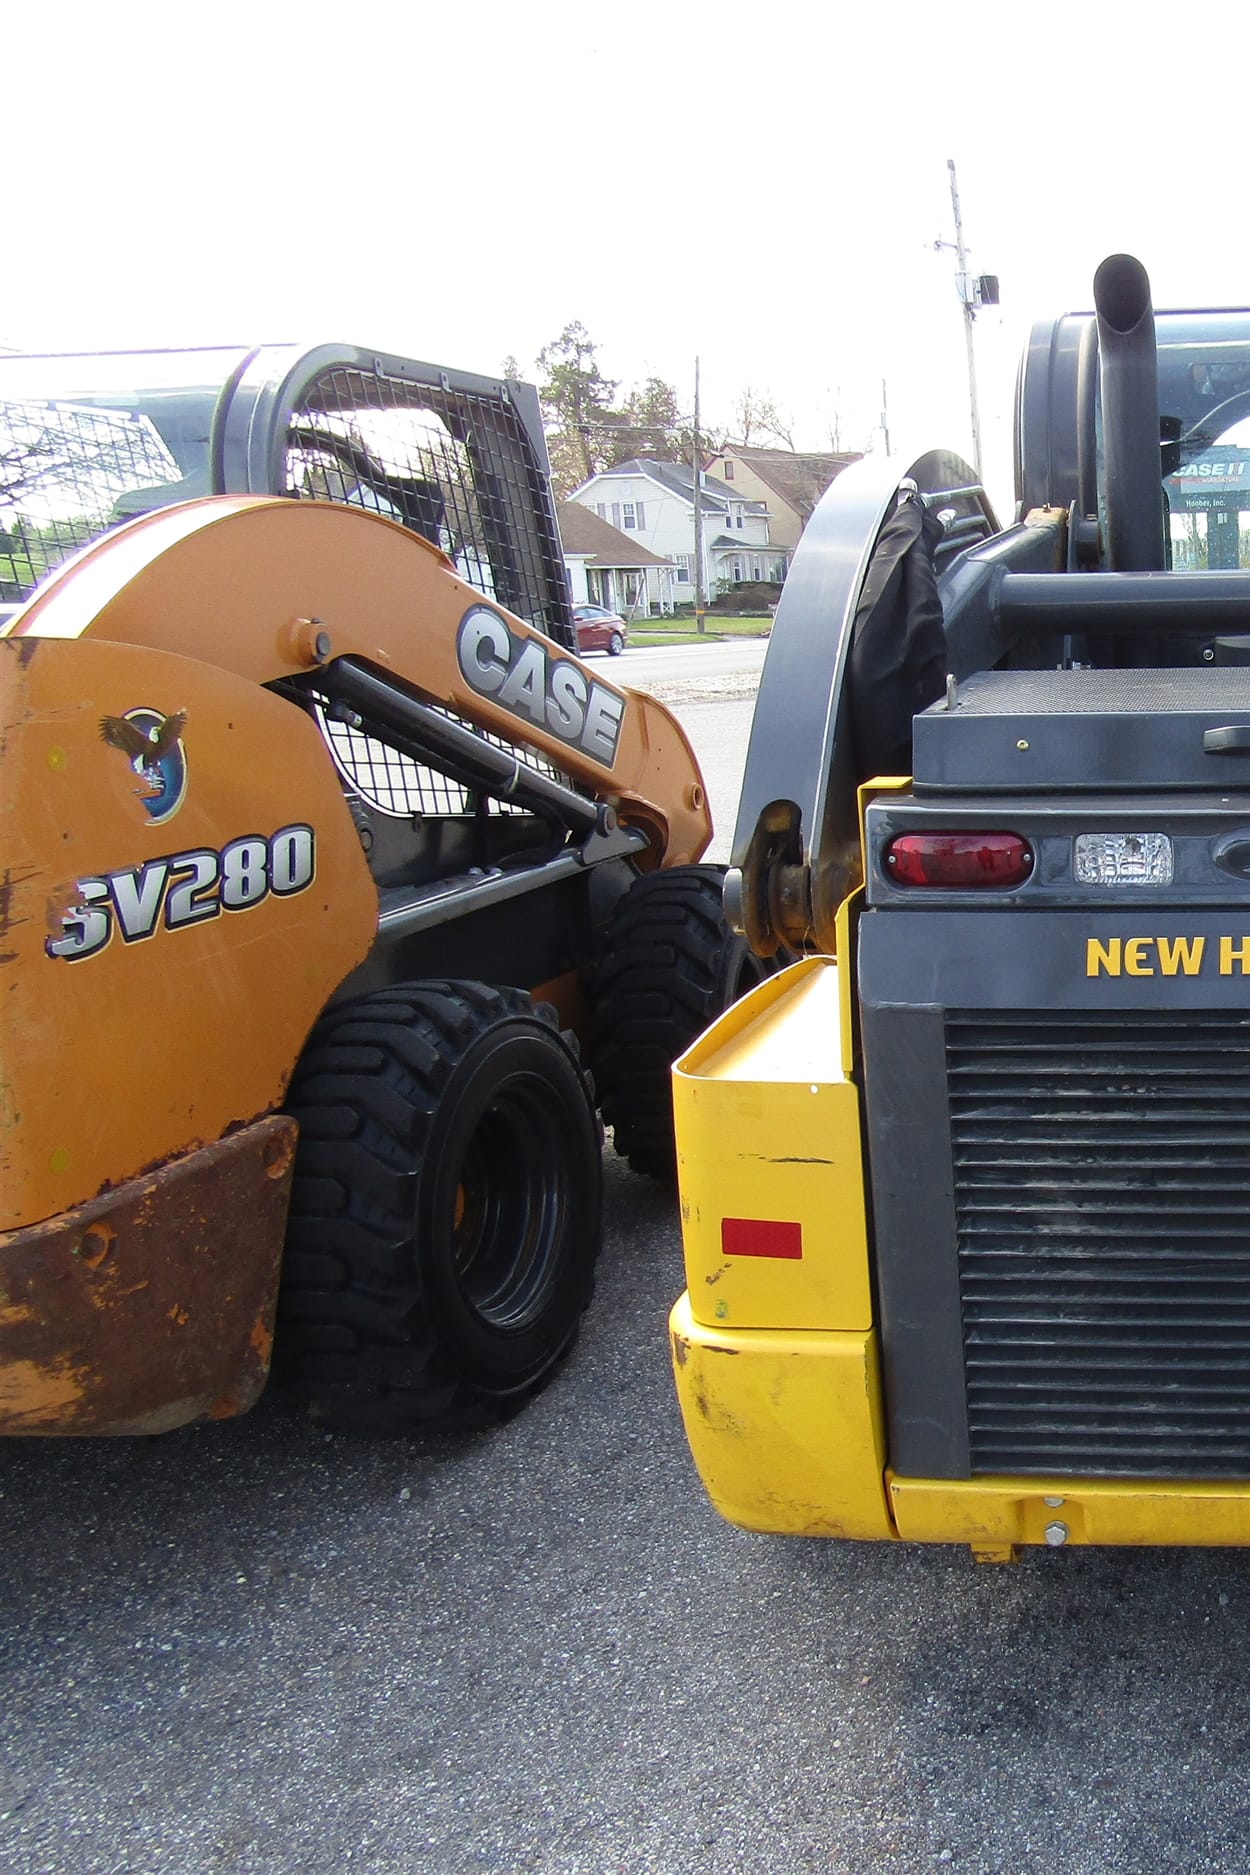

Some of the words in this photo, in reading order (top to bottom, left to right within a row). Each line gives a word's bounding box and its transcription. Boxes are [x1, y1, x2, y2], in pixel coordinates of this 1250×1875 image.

[1212, 499, 1226, 507] Inc.
[459, 608, 626, 766] CASE
[1086, 937, 1205, 976] NEW
